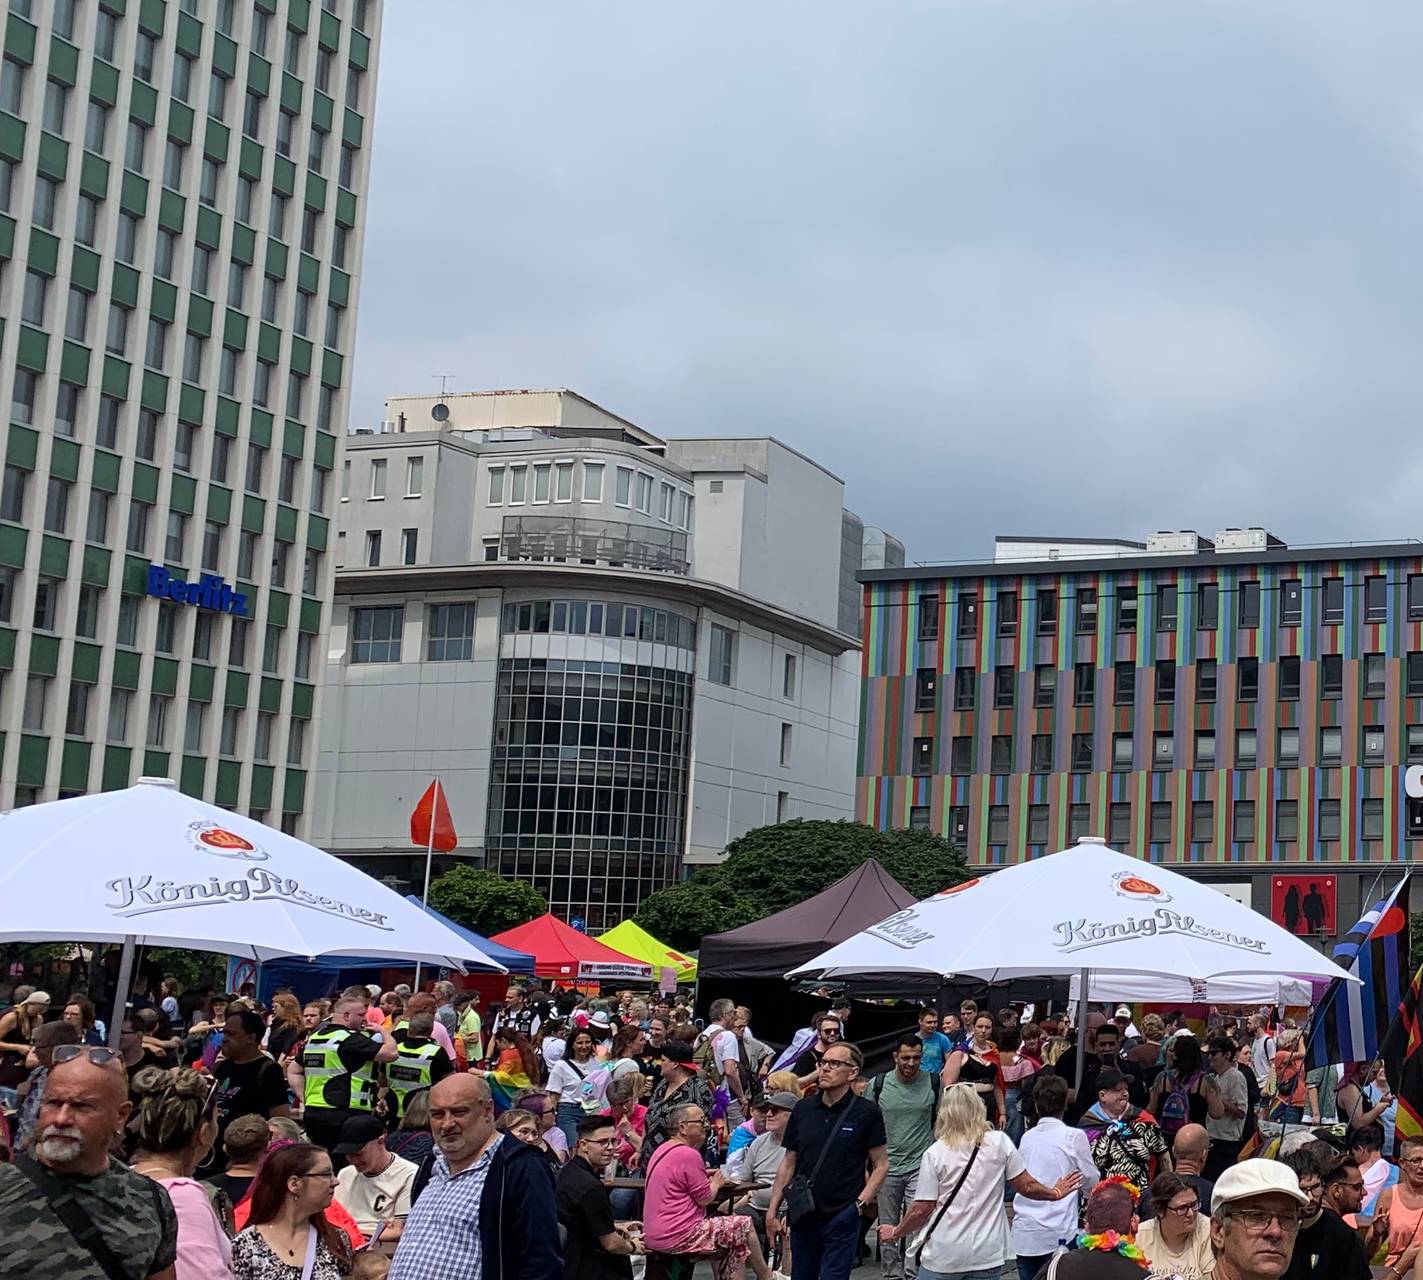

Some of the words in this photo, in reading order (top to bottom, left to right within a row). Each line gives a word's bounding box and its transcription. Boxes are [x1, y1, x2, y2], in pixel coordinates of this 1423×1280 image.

[147, 565, 248, 616] Berlitz
[105, 875, 250, 909] König
[247, 867, 388, 926] Pilsener
[1053, 917, 1158, 947] König
[1154, 908, 1266, 951] Pilsener
[374, 1194, 386, 1212] C
